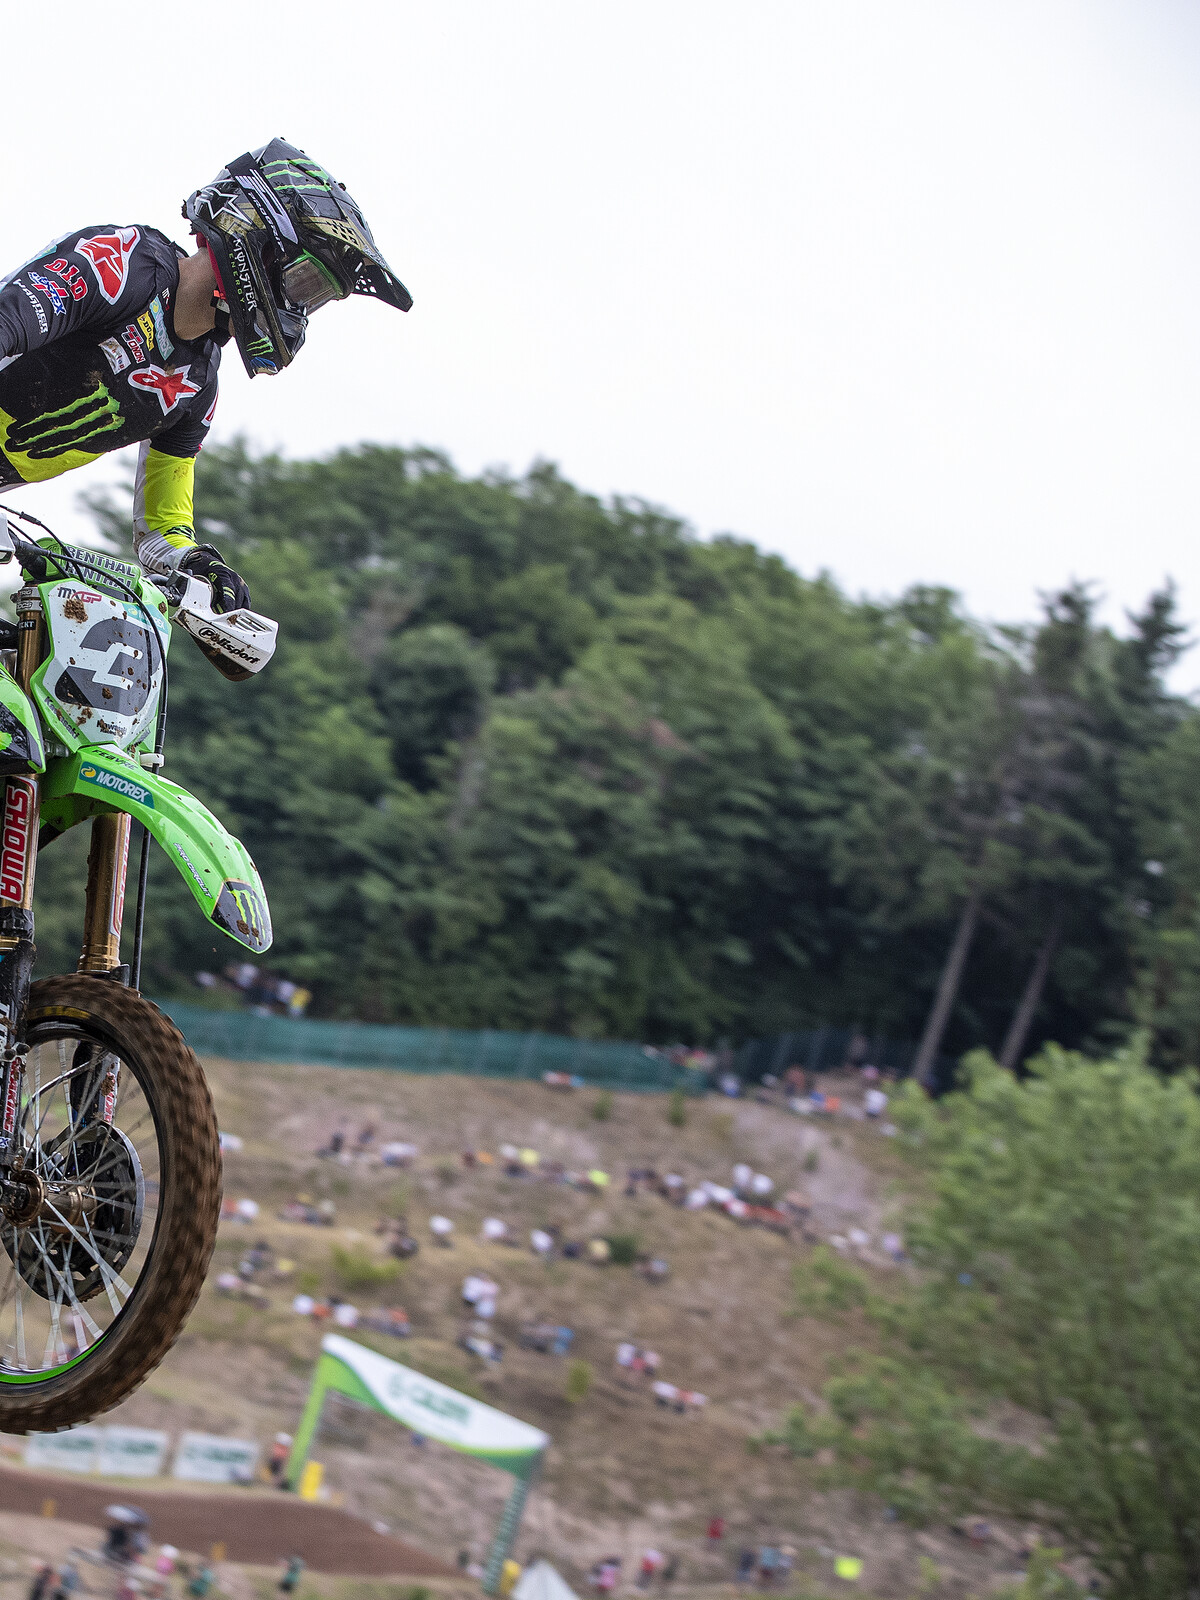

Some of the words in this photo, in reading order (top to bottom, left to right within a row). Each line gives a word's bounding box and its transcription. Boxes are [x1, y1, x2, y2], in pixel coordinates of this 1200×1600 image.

[233, 238, 258, 312] MONSTER
[55, 618, 151, 717] 3
[199, 627, 260, 664] Polisport
[96, 771, 150, 803] MOTOREX
